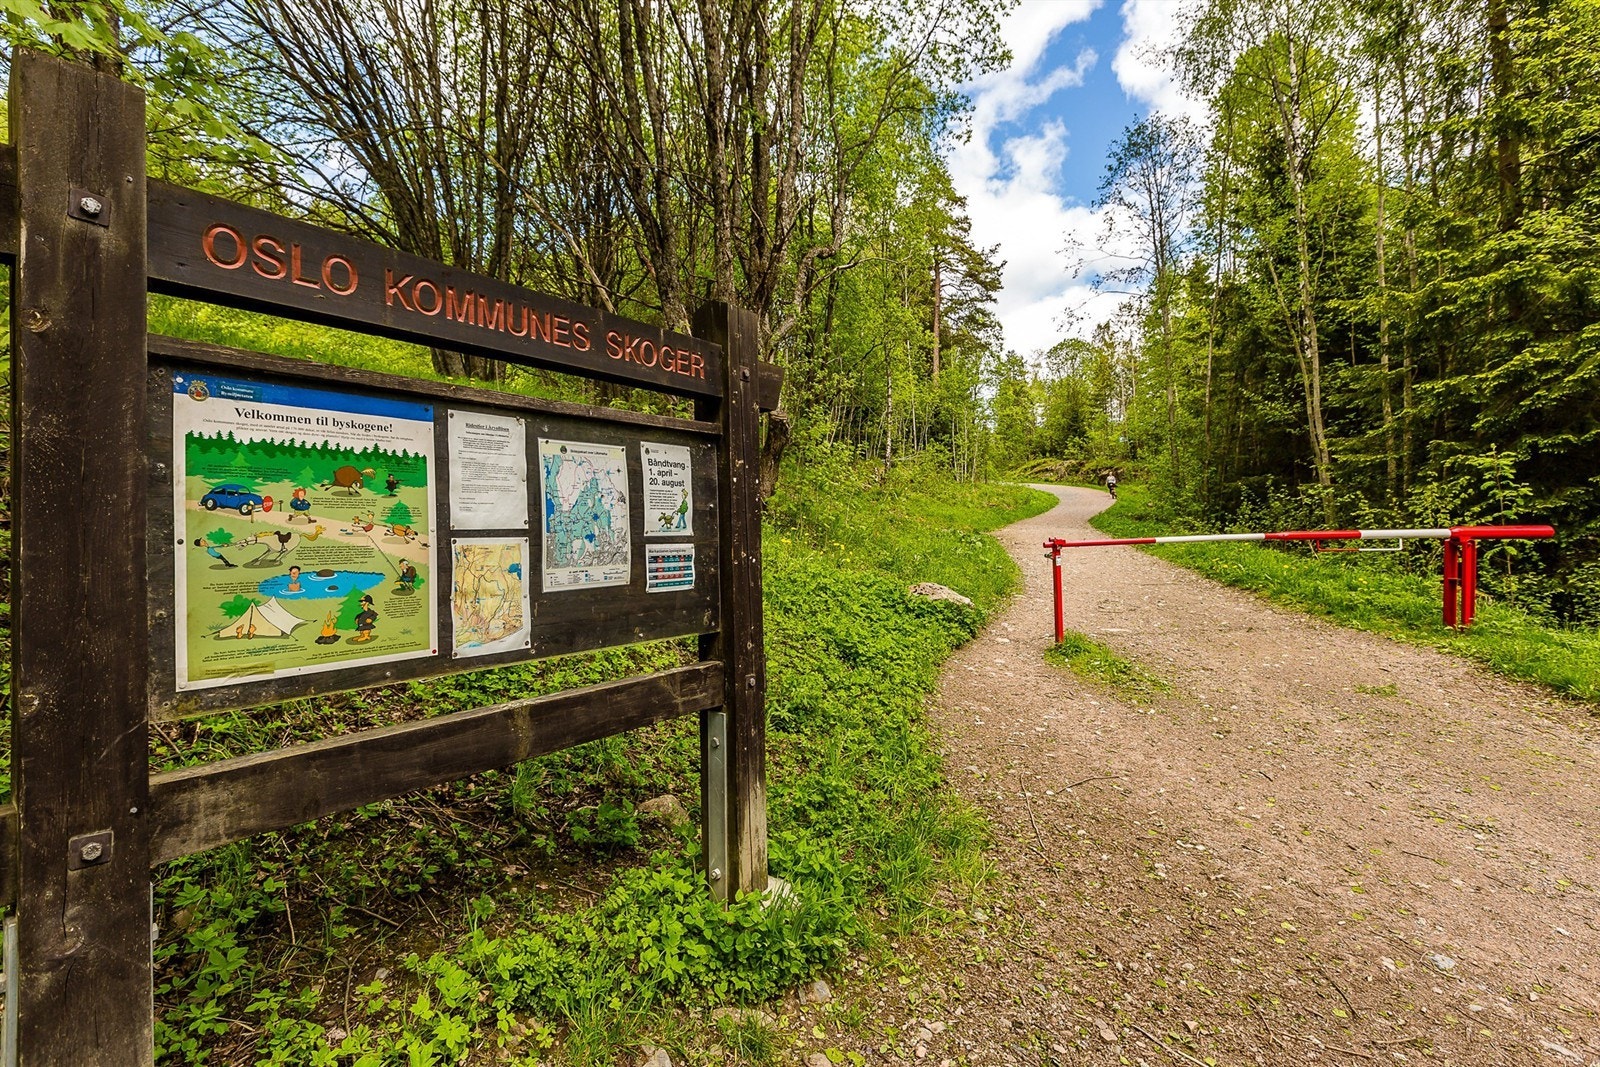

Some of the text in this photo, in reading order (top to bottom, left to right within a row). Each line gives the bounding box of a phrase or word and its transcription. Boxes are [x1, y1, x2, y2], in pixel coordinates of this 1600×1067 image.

[202, 222, 705, 379] OSLO KOMMUNES SKOGER
[234, 407, 311, 425] Velkommen
[316, 416, 328, 426] til
[332, 418, 393, 432] byskogene!
[647, 458, 686, 470] Båndtvang
[649, 468, 656, 476] 1.
[657, 469, 673, 478] april
[649, 477, 685, 488] 20. august
